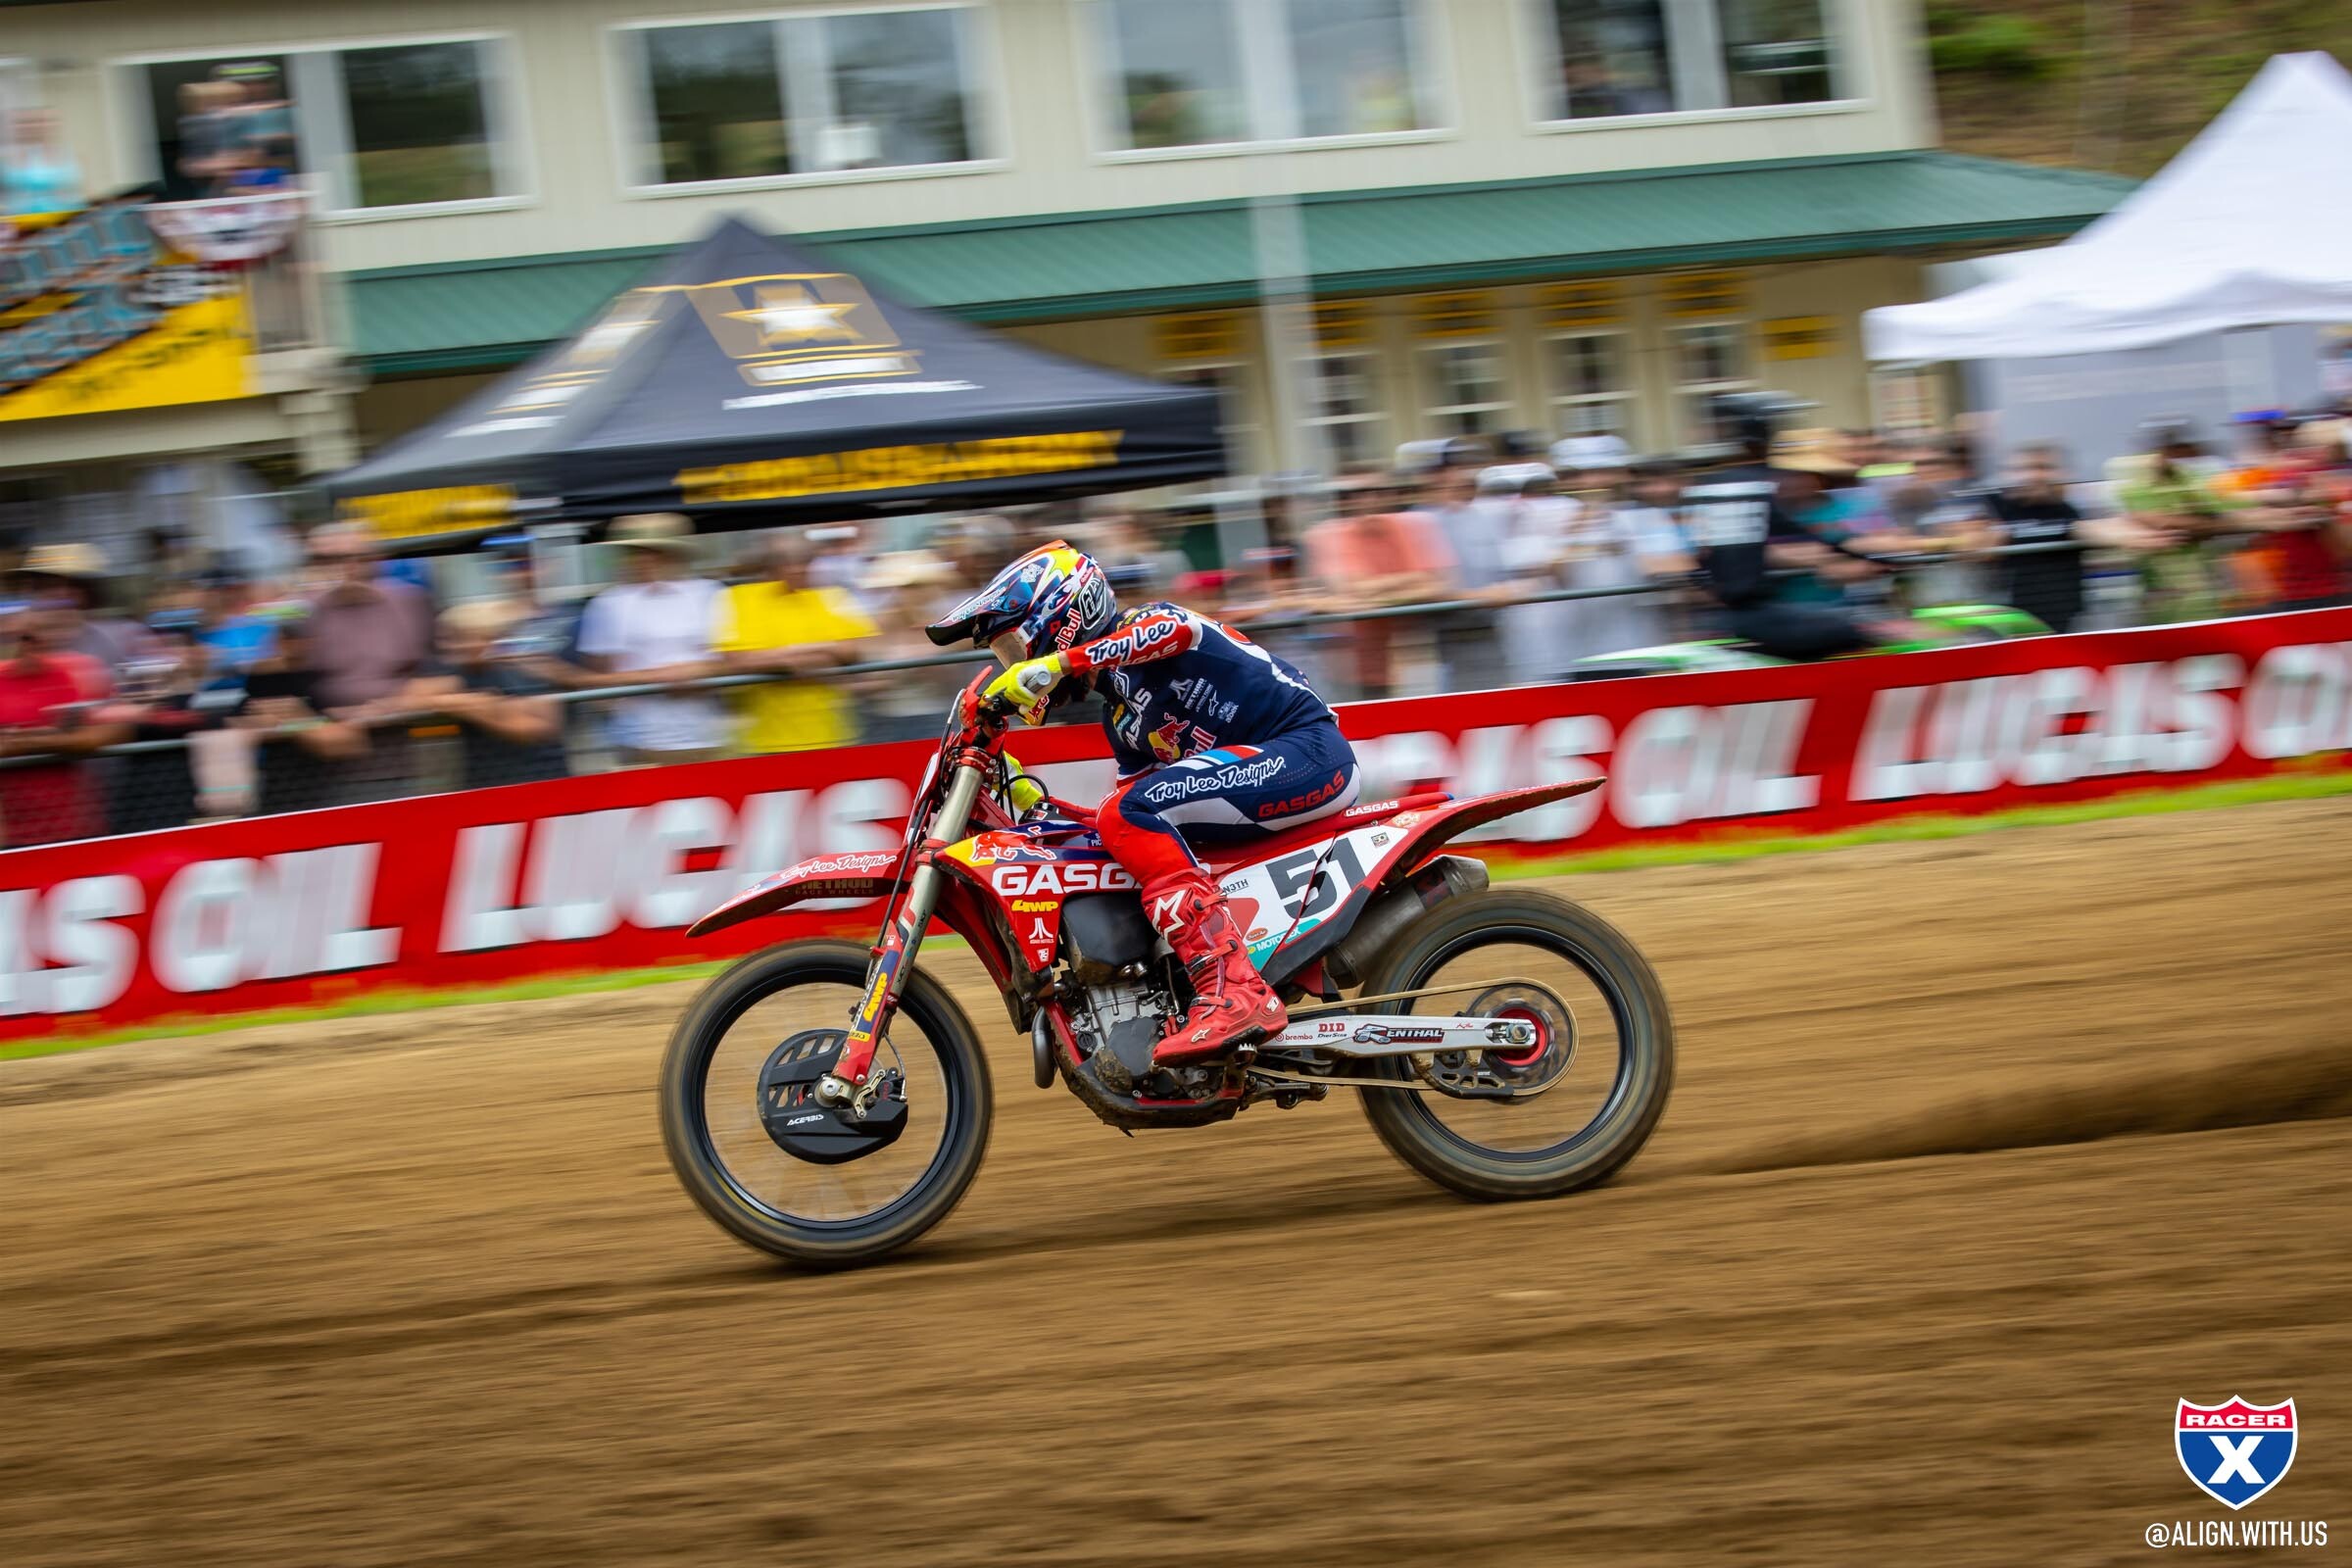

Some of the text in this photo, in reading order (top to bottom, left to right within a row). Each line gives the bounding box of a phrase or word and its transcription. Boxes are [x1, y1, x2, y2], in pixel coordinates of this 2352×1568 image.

[1086, 633, 1133, 664] Troy
[1132, 619, 1177, 654] Lee
[1145, 757, 1286, 803] Troy Lee Designs
[1257, 770, 1346, 818] GASGAS
[1344, 799, 1400, 817] GASGAS
[809, 859, 838, 874] Lee
[836, 854, 897, 873] Designs
[991, 862, 1143, 897] GASG
[1265, 836, 1368, 919] 51
[1222, 878, 1250, 894] N3TH
[787, 1113, 825, 1127] ACERBIS
